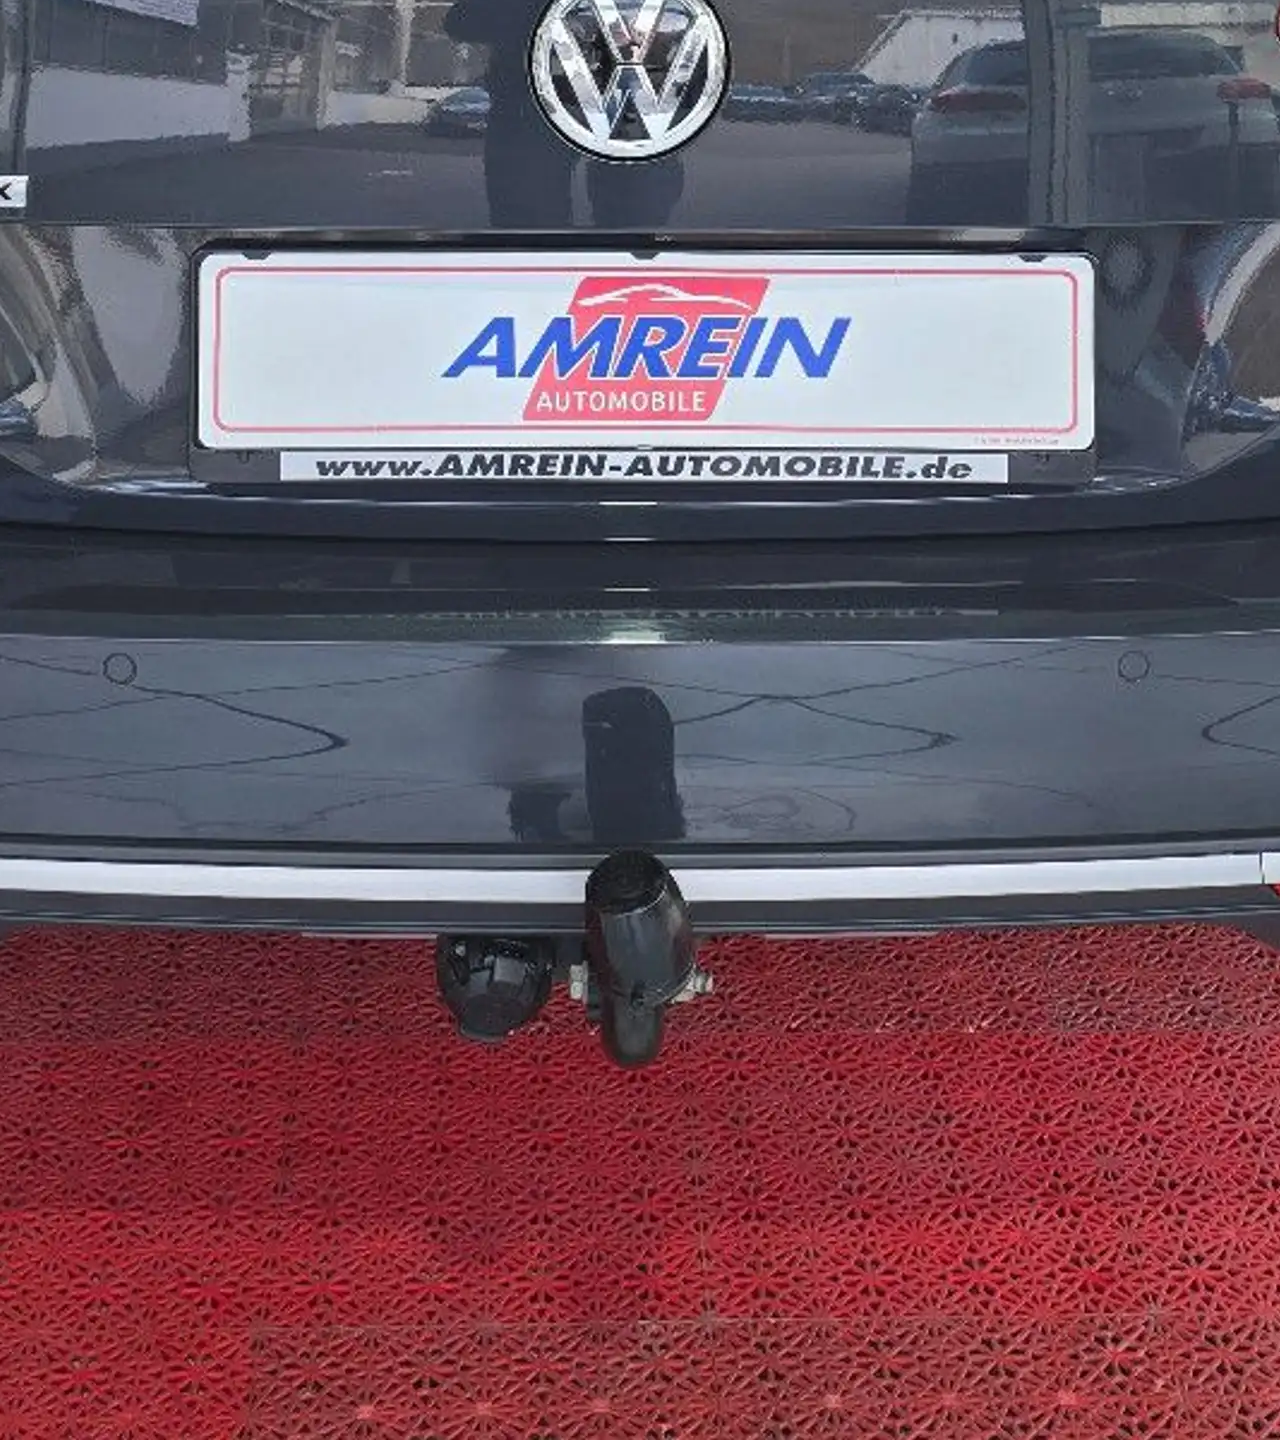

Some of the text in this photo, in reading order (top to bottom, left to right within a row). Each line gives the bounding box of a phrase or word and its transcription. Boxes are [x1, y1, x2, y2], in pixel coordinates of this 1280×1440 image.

[441, 316, 852, 379] AMREIN
[535, 390, 707, 413] AUTOMOBILE
[316, 452, 974, 482] www.AMREIN-AUTOMOBILE.de
